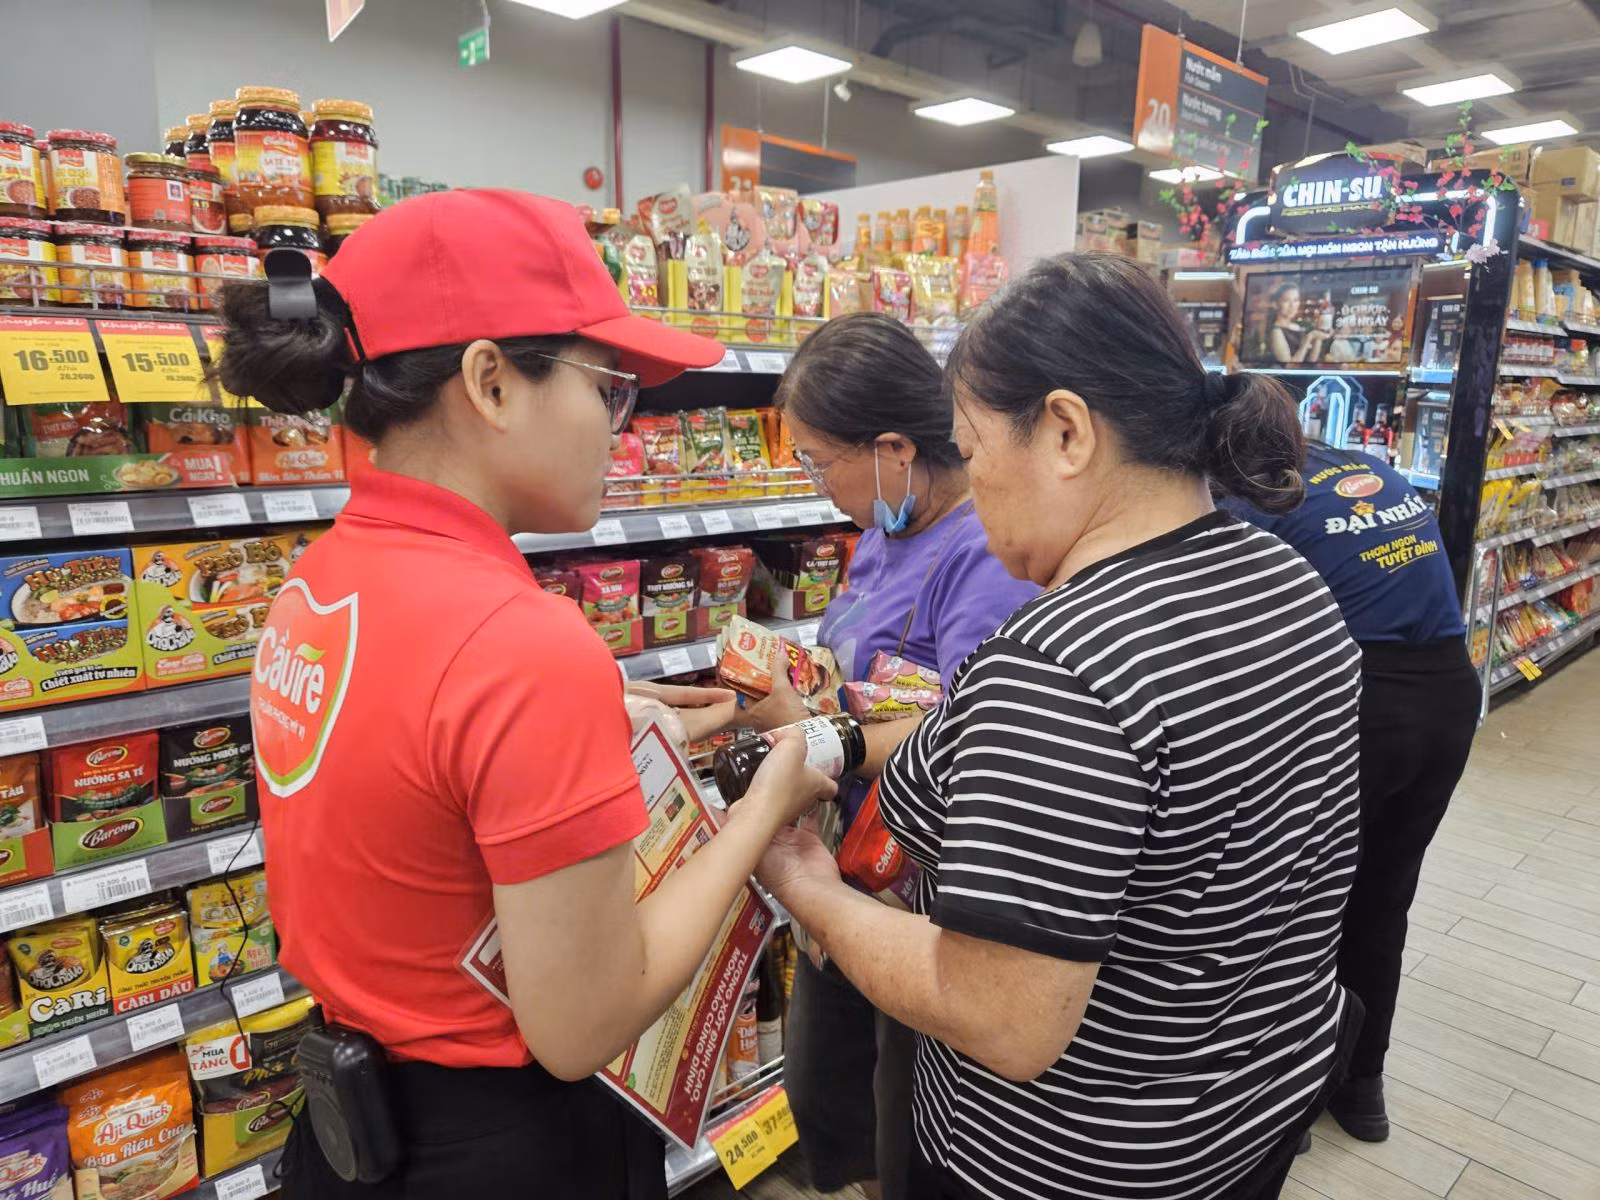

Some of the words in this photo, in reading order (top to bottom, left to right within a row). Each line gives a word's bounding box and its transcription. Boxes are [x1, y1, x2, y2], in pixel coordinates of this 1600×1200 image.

[1283, 176, 1382, 208] CHIN-SU
[47, 469, 90, 484] NGON
[1325, 513, 1378, 535] ĐẠI
[1376, 493, 1427, 525] NHẤT
[1360, 543, 1391, 562] THƠM
[1391, 534, 1417, 550] NGON
[1376, 546, 1414, 569] TUYỆT
[117, 771, 131, 780] SA
[85, 820, 136, 846] Barona
[191, 1056, 229, 1073] TẶNG
[203, 1048, 225, 1058] MUA
[97, 1103, 169, 1144] Aji-Quick
[120, 1138, 155, 1159] Riêu
[158, 1123, 185, 1144] Cua
